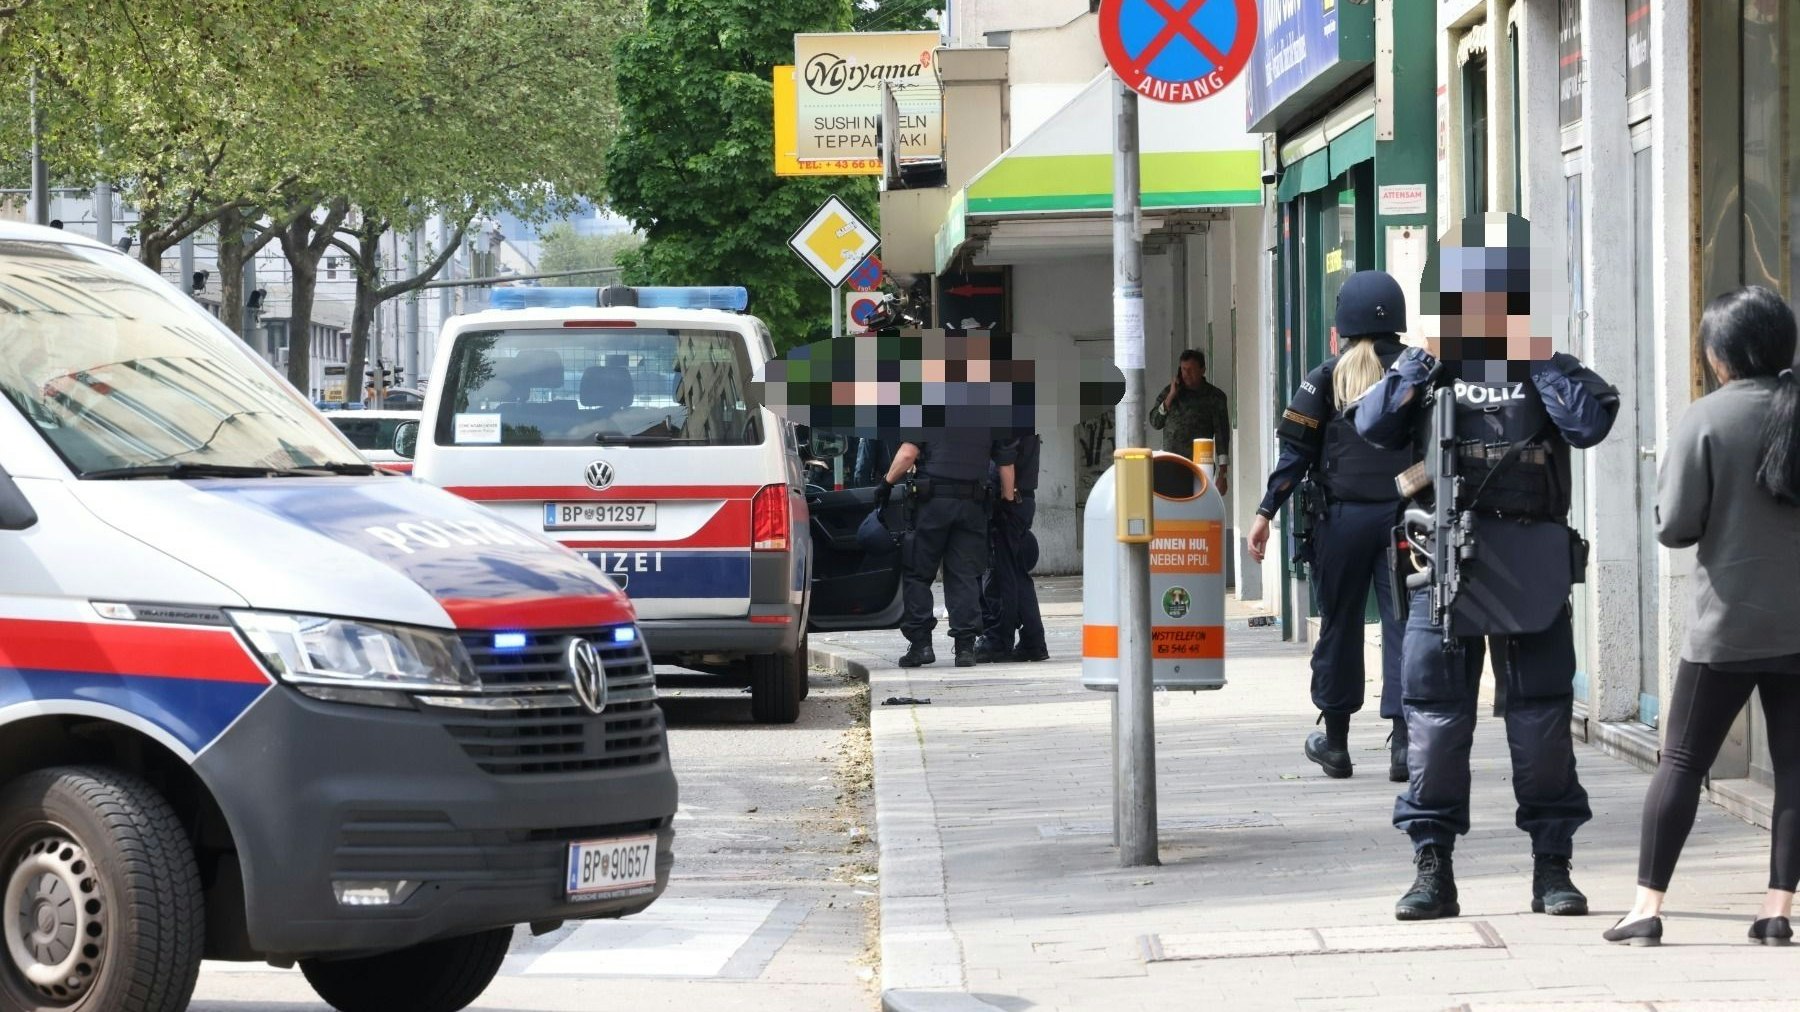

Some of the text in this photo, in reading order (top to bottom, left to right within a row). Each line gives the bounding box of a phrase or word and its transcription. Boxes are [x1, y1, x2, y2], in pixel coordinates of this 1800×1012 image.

[1137, 71, 1224, 101] ANFANG
[814, 115, 927, 130] SUSHI NELN
[814, 133, 927, 149] TEPPAAKI
[798, 160, 822, 170] TEL:
[834, 160, 849, 169] 43
[852, 160, 866, 169] 66
[1383, 191, 1422, 199] ATTENSAM
[562, 506, 646, 522] BP 91297
[1149, 537, 1209, 553] INNEN HUI,
[138, 609, 220, 620] TRANSPORTER
[583, 845, 650, 883] BP 90657
